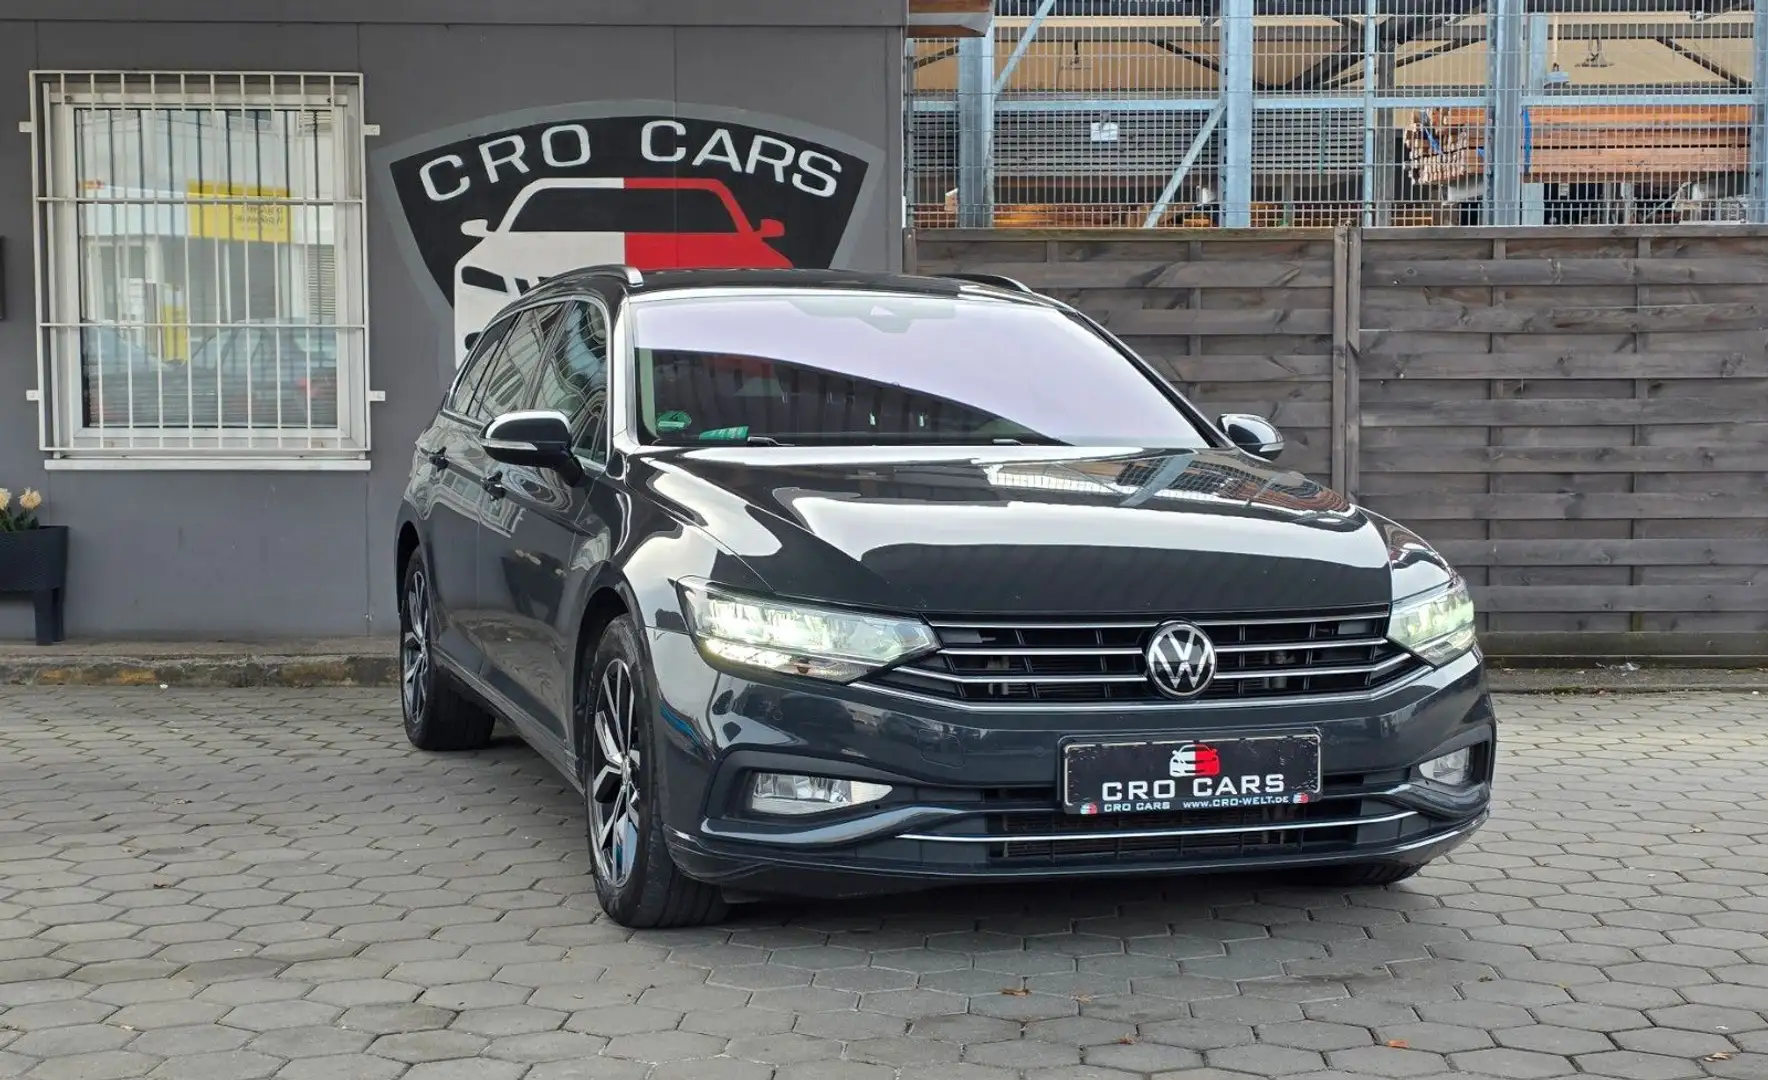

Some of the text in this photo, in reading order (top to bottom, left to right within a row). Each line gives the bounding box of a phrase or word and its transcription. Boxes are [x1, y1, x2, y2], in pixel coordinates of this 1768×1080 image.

[419, 120, 842, 202] CRO CARS
[1102, 774, 1285, 801] CRO CARS
[1104, 803, 1132, 812] CRO
[1136, 801, 1171, 811] CARS
